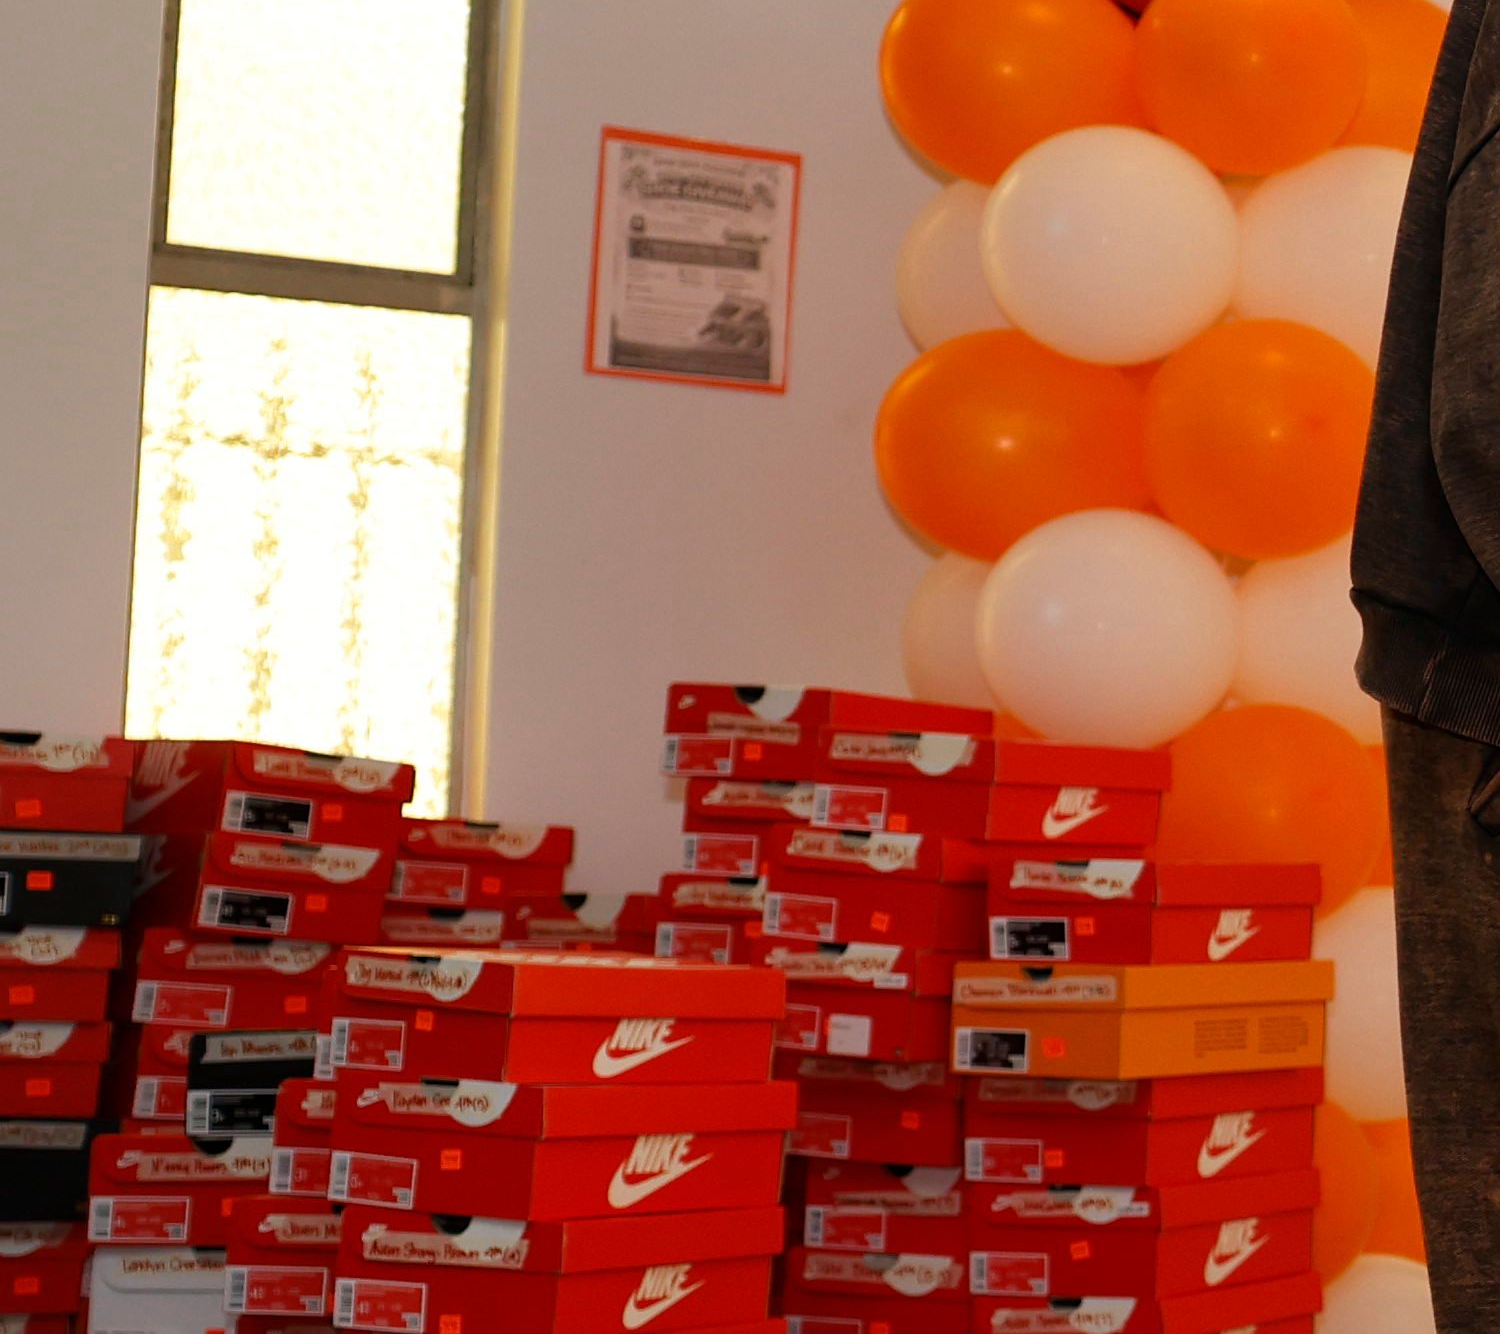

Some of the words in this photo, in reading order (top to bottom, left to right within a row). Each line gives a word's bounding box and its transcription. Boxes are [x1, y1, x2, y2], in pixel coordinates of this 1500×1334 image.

[614, 1018, 676, 1050] NIKE
[626, 1134, 693, 1176] NIKE
[638, 1263, 692, 1302] NIKE
